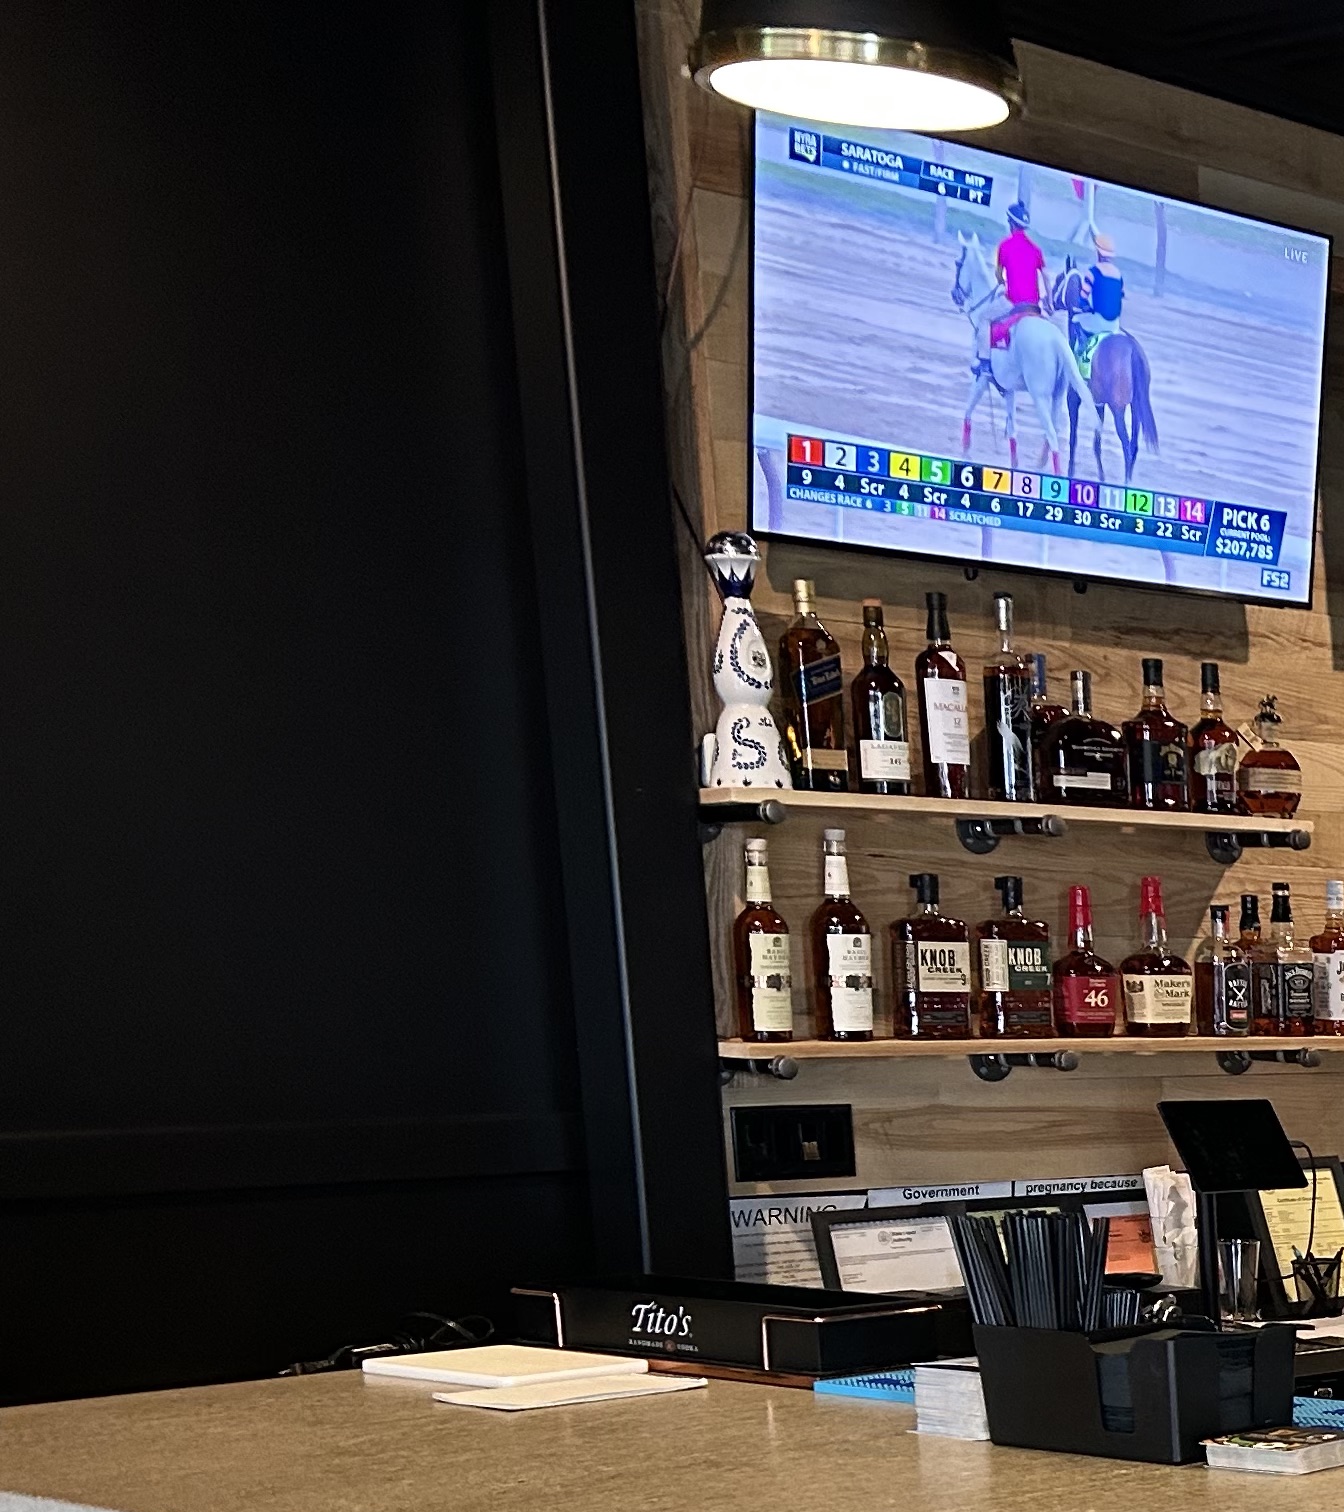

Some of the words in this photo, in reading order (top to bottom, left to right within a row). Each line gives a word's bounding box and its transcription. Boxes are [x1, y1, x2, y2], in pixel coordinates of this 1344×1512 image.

[841, 142, 904, 170] SARATOGA
[852, 161, 900, 183] FAST/FIRM
[929, 164, 955, 182] RACE
[964, 173, 986, 188] MTP
[937, 181, 947, 196] 6
[968, 189, 984, 204] PT
[1284, 246, 1309, 264] LIVE
[802, 440, 811, 463] 1
[836, 446, 847, 467] 2
[867, 450, 881, 473] 3
[899, 457, 911, 476] 4
[929, 460, 943, 483] 5
[960, 465, 975, 488] 6
[992, 471, 1003, 490] 7
[1021, 476, 1033, 495] 8
[1051, 480, 1062, 499] 9
[1075, 483, 1095, 505] 10
[1104, 487, 1121, 510] 11
[1131, 493, 1149, 514] 12
[1158, 496, 1176, 517] 13
[1184, 500, 1204, 523] 14
[789, 487, 837, 504] CHANGES
[837, 492, 862, 508] RACE
[865, 497, 873, 509] 6
[884, 500, 891, 513] 3
[901, 501, 909, 515] 5
[933, 506, 946, 520] 14
[949, 509, 1002, 527] SCRATCHED
[802, 469, 813, 485] 9
[834, 474, 846, 491] 4
[860, 477, 885, 497] Scr
[898, 484, 910, 500] 4
[923, 487, 948, 506] Scr
[960, 493, 971, 509] 4
[990, 497, 1001, 512] 6
[1017, 501, 1035, 518] 17
[1045, 504, 1064, 522] 29
[1073, 509, 1092, 527] 30
[1100, 512, 1122, 531] Scr
[1134, 518, 1144, 534] 3
[1156, 521, 1174, 538] 22
[1181, 525, 1203, 542] Scr
[1222, 507, 1259, 531] PICK
[1260, 514, 1271, 532] 6
[1215, 536, 1274, 560] $207,785
[1262, 569, 1289, 589] FS2
[889, 757, 902, 765] 16
[920, 948, 956, 967] KNOB
[1008, 947, 1042, 966] KNOB
[927, 966, 963, 974] CREEK
[1014, 965, 1048, 973] CREEK
[960, 973, 967, 986] 9
[1154, 979, 1191, 988] Maker's
[1084, 989, 1109, 1007] 46
[1165, 989, 1191, 998] Mark
[902, 1185, 980, 1200] Government
[1025, 1180, 1087, 1195] pregnancy
[1090, 1178, 1138, 1190] because
[631, 1300, 692, 1337] Tito's
